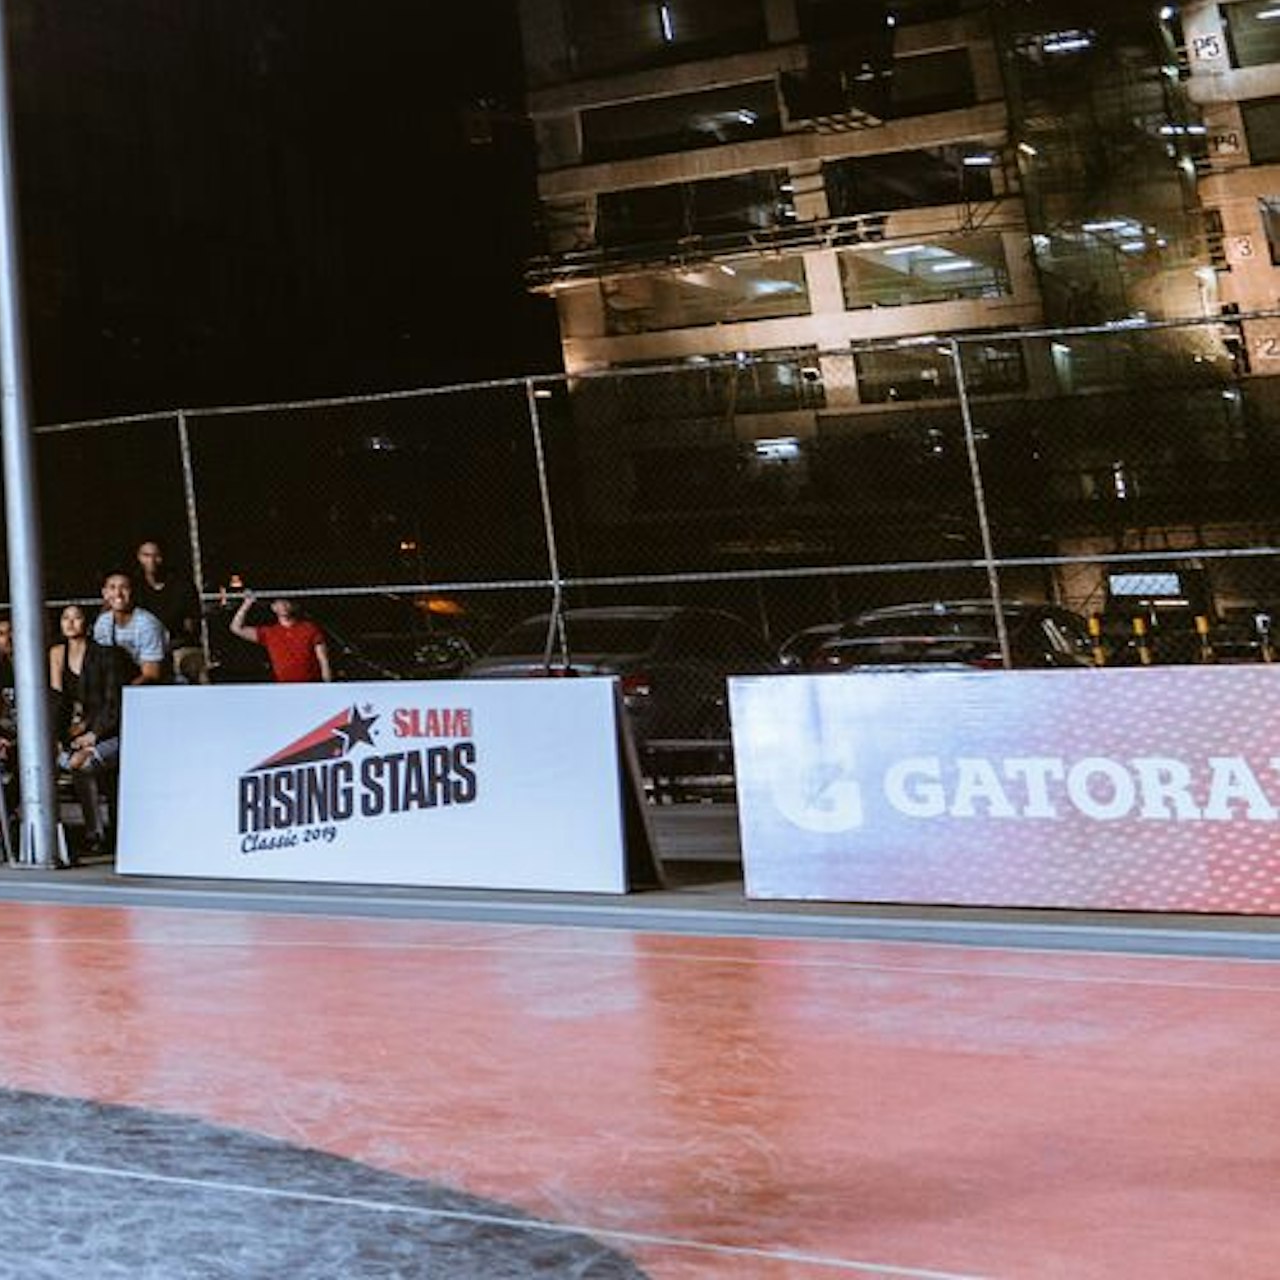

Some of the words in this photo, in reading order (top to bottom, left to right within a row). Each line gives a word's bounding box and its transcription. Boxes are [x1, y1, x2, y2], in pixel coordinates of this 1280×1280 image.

[239, 760, 354, 835] RISING
[360, 741, 477, 817] STARS
[883, 756, 1280, 821] GATORA
[241, 830, 299, 854] Classic
[303, 826, 337, 845] 2019
